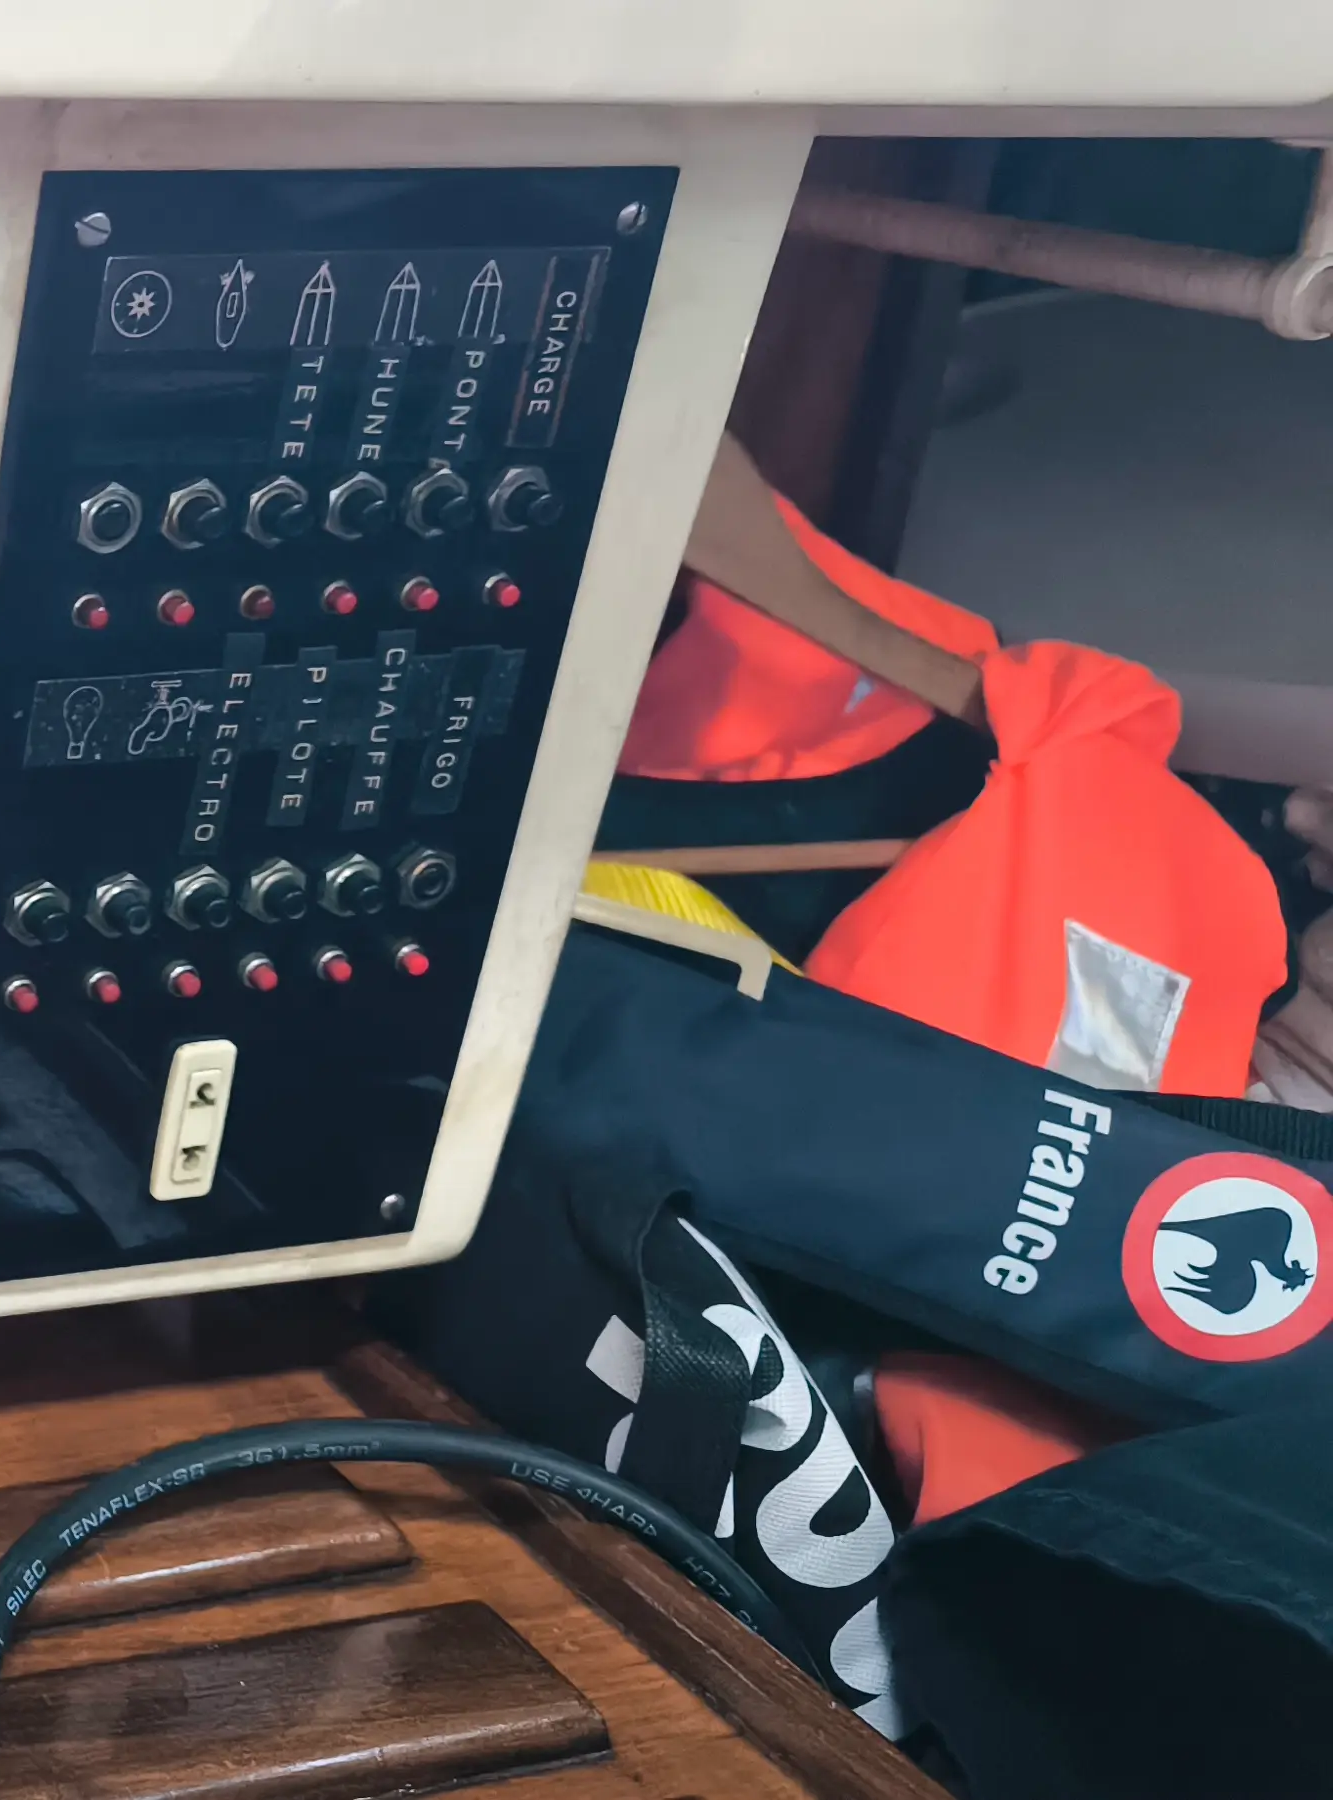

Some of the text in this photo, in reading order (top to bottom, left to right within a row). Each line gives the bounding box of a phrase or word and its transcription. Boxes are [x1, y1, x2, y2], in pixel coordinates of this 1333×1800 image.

[281, 354, 325, 460] TETE
[356, 357, 400, 462] HUNE
[442, 349, 485, 453] PONT
[526, 289, 577, 417] CHARGE
[193, 671, 252, 843] ELECTRO
[279, 666, 327, 811] PILOTE
[353, 646, 407, 816] CHAUFFE
[430, 695, 475, 790] FRIGO
[982, 1087, 1113, 1297] France
[511, 1462, 571, 1492] USE
